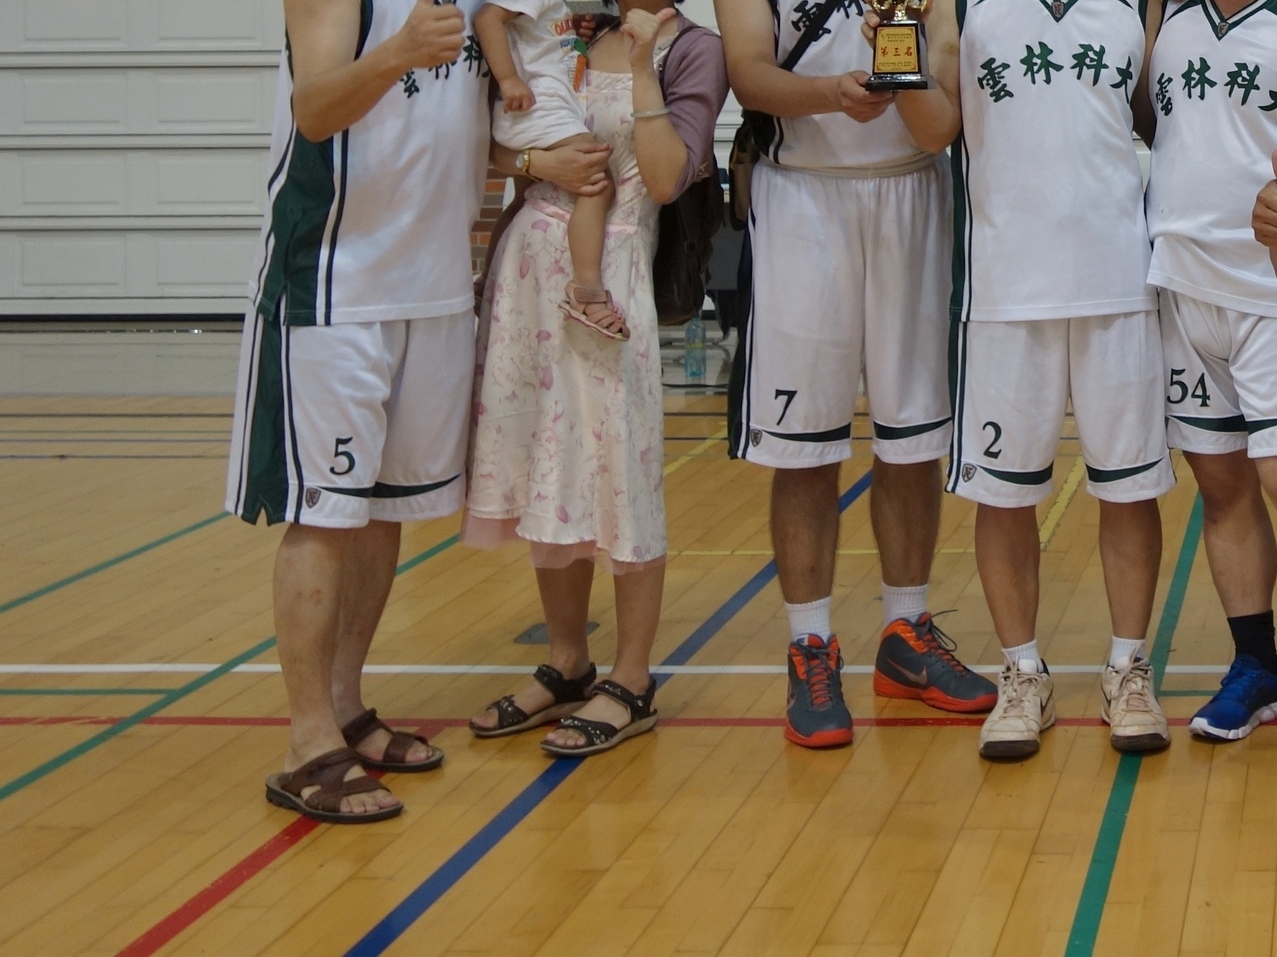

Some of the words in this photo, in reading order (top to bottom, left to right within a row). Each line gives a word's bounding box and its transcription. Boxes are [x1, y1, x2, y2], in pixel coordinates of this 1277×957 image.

[977, 41, 1134, 103] 雲林科大
[774, 388, 798, 426] 7
[1166, 368, 1211, 408] 54
[329, 436, 356, 476] 5
[982, 421, 1002, 460] 2
